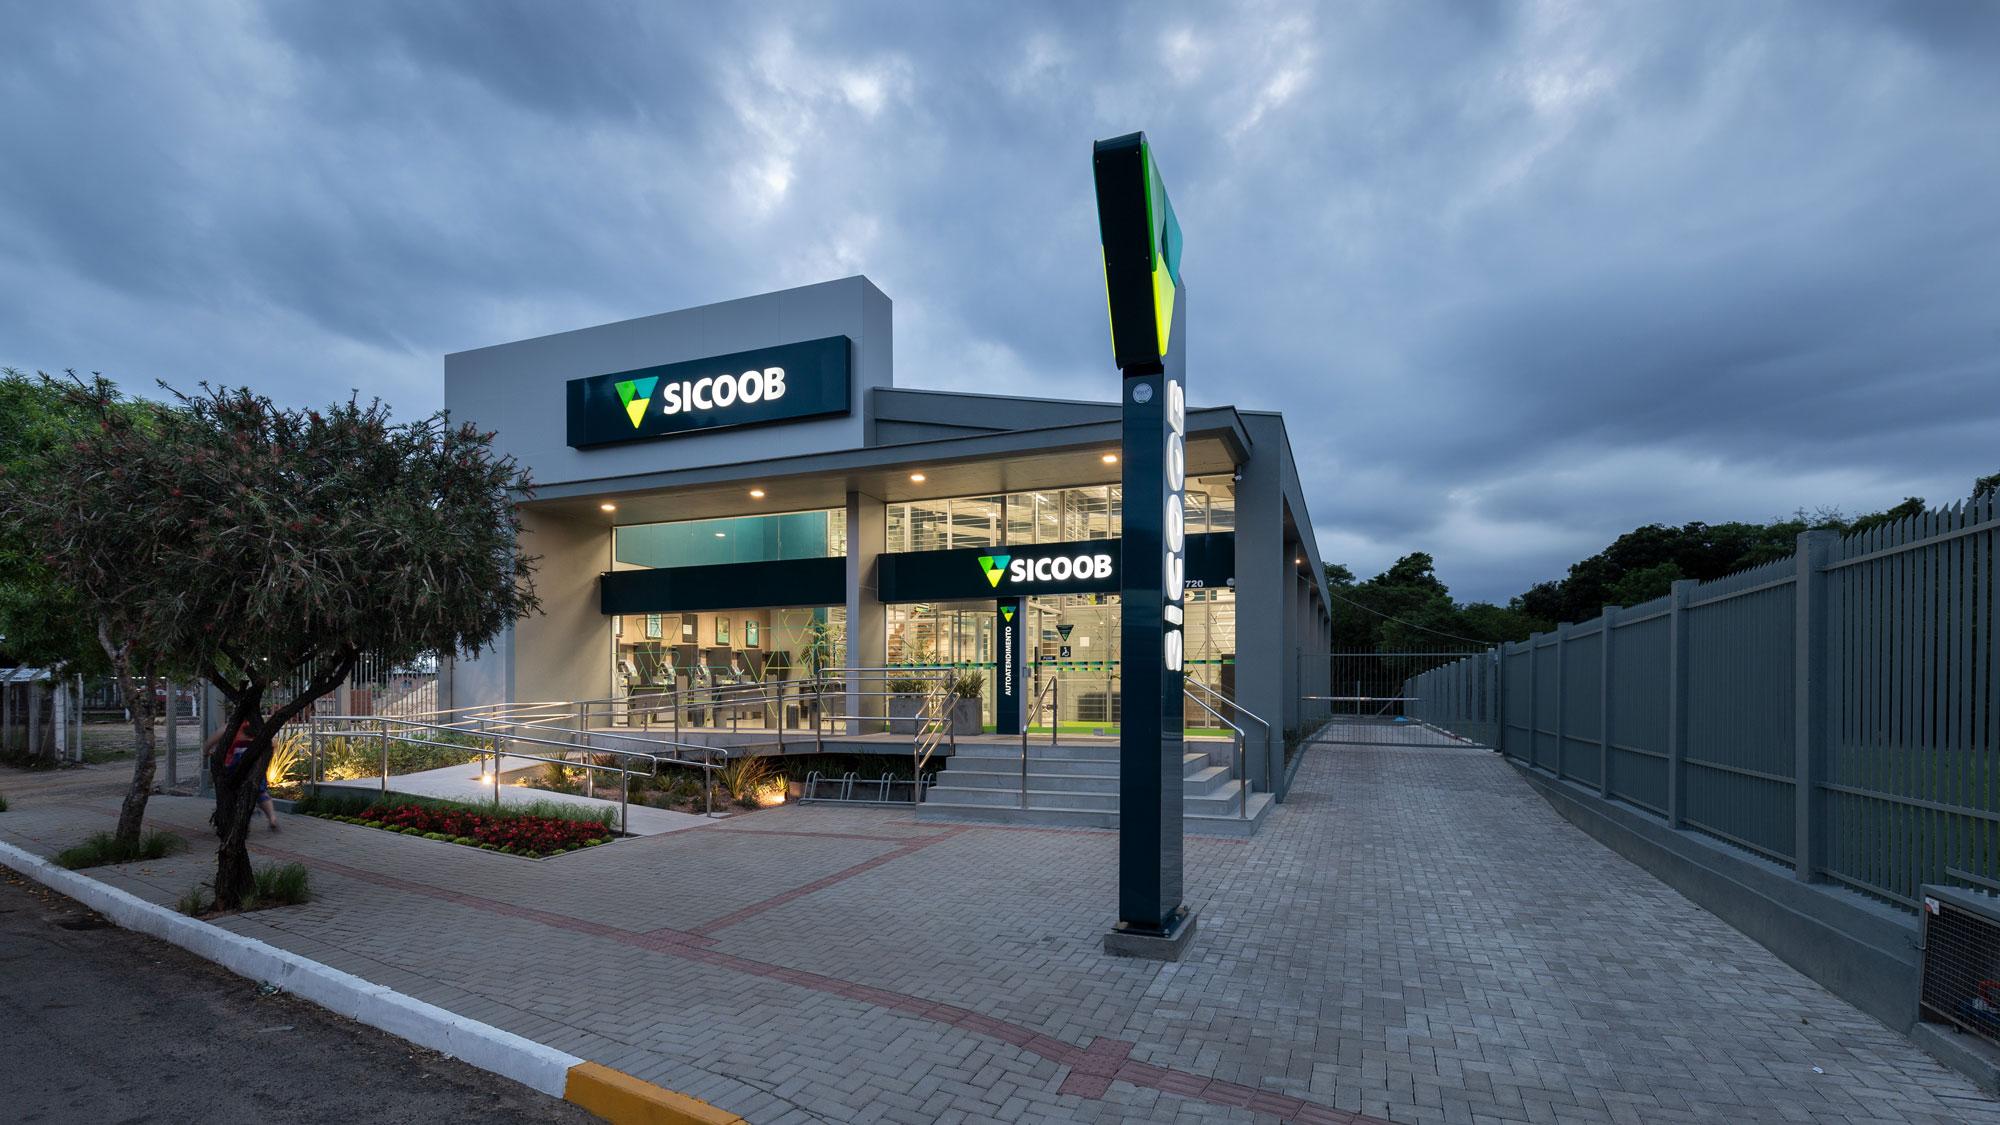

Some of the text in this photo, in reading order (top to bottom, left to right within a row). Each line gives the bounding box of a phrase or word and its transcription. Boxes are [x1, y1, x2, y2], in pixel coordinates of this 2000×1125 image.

[663, 367, 785, 414] SICOOB
[1165, 379, 1183, 671] SICOOB
[1010, 554, 1112, 582] SICOOB
